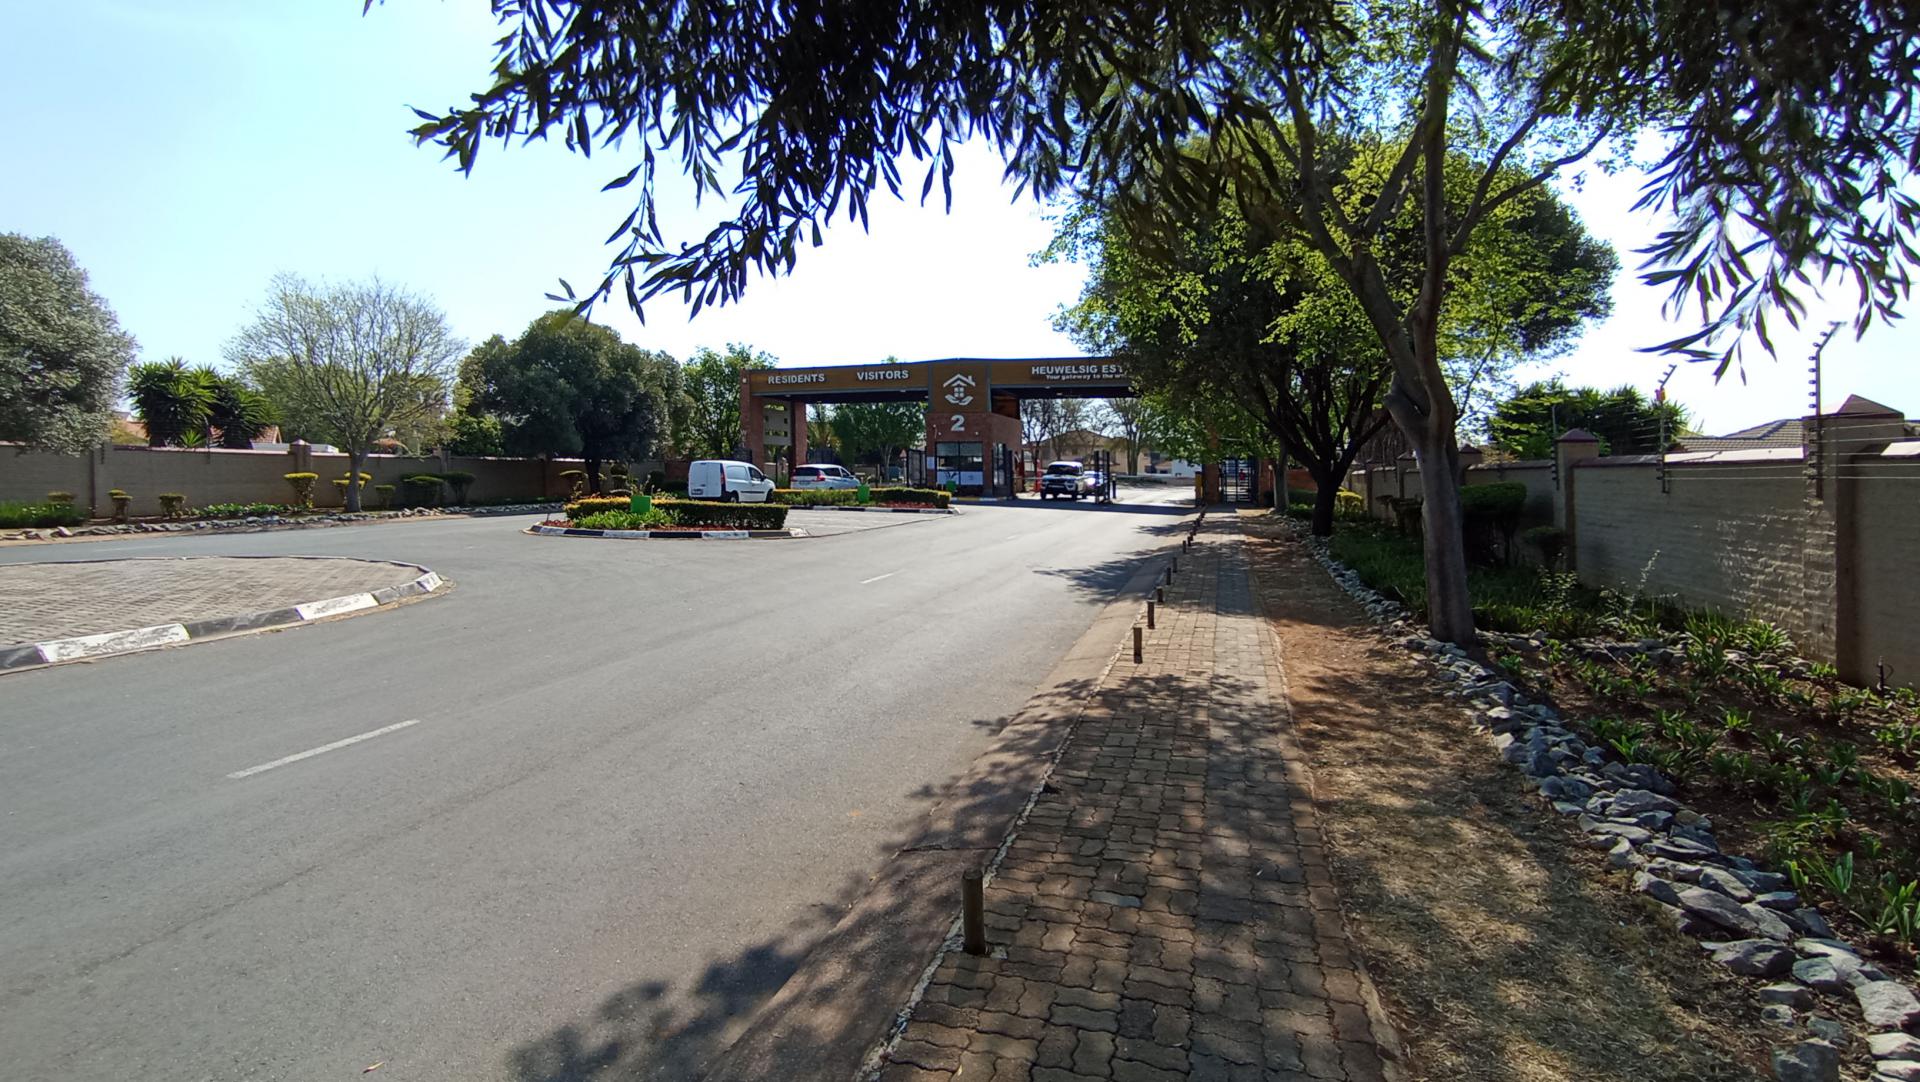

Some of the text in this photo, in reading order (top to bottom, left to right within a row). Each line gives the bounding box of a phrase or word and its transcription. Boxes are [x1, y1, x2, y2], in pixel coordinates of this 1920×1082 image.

[857, 369, 909, 381] VISITORS
[1031, 365, 1098, 375] HEUWELSIG
[768, 373, 825, 385] RESIDENTS
[950, 414, 965, 432] 2
